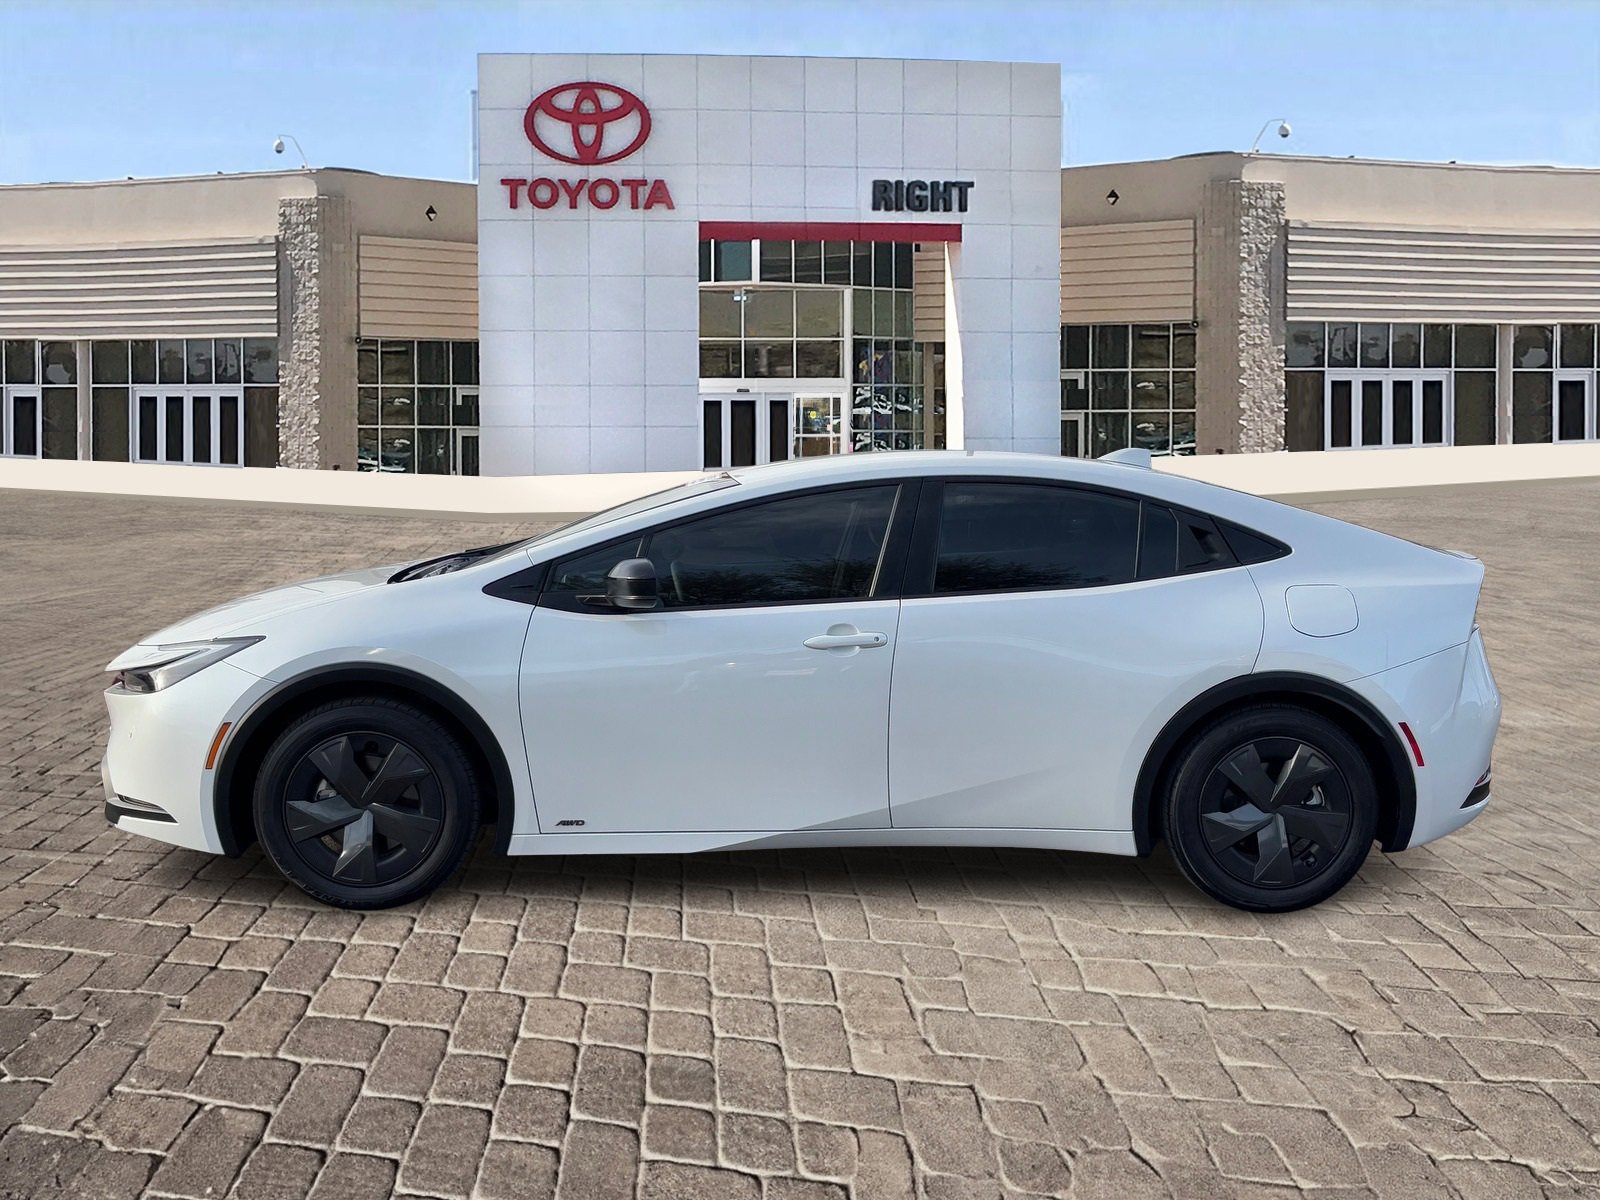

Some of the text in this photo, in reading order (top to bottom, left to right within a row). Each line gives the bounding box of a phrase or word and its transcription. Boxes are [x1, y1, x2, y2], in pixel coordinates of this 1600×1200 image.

[501, 178, 675, 210] TOYOTA
[872, 179, 975, 213] RIGHT
[555, 819, 586, 827] AWD
